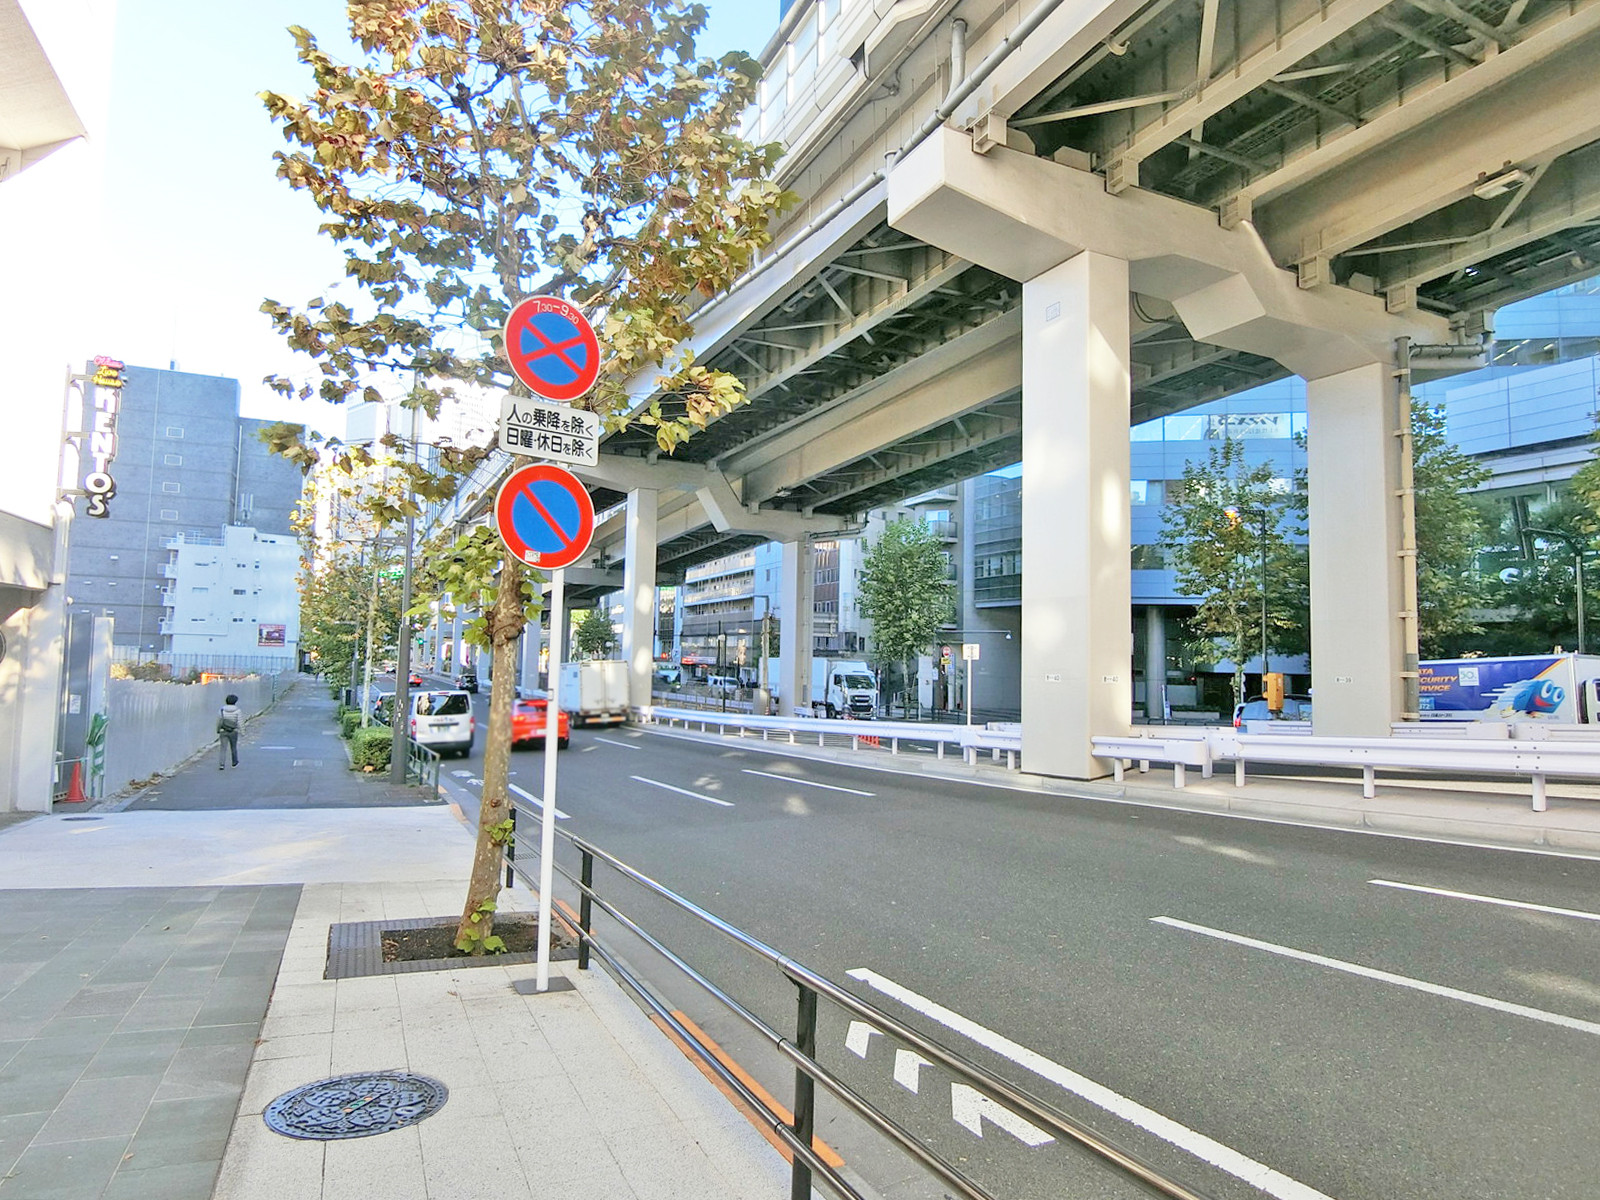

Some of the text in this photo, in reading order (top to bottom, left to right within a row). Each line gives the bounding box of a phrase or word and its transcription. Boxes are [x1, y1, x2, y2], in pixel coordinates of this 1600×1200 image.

[506, 403, 594, 437] 人の乗降を除く
[1419, 675, 1458, 684] CURITY
[1418, 684, 1452, 692] RVICE
